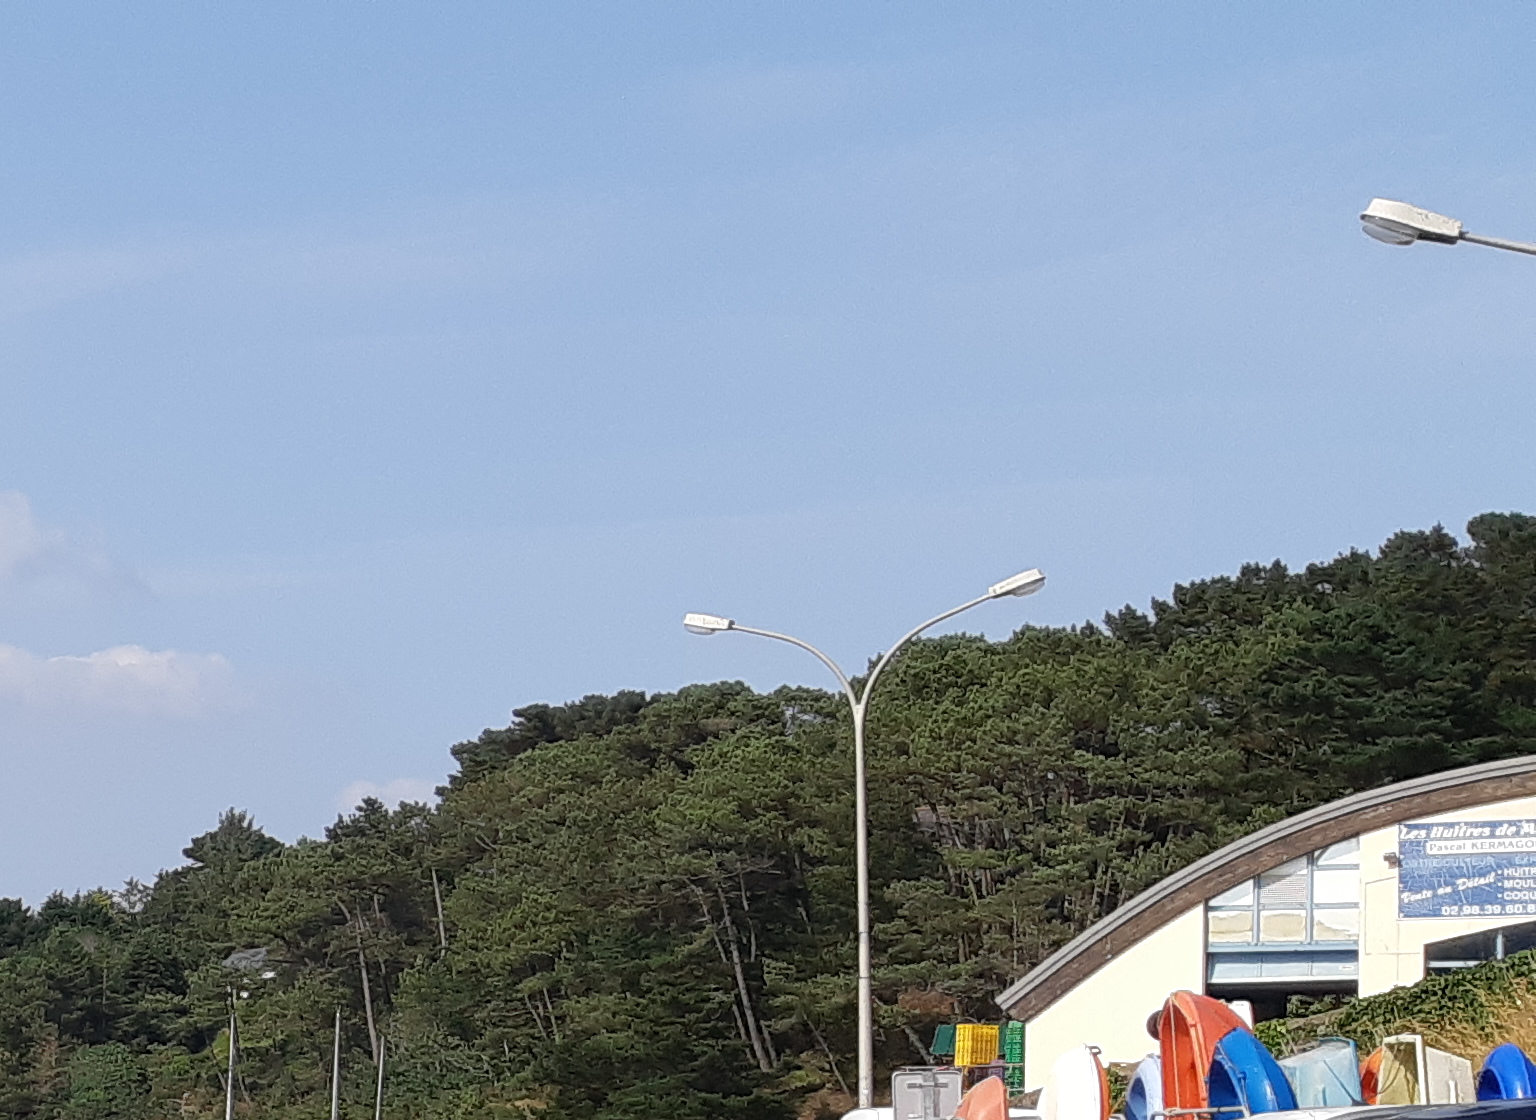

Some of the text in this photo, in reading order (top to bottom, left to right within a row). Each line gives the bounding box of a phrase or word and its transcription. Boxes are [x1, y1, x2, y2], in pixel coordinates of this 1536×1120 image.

[1399, 825, 1427, 839] Les
[1495, 823, 1517, 836] de
[1429, 843, 1466, 852] Pascal
[1401, 890, 1433, 903] Vente
